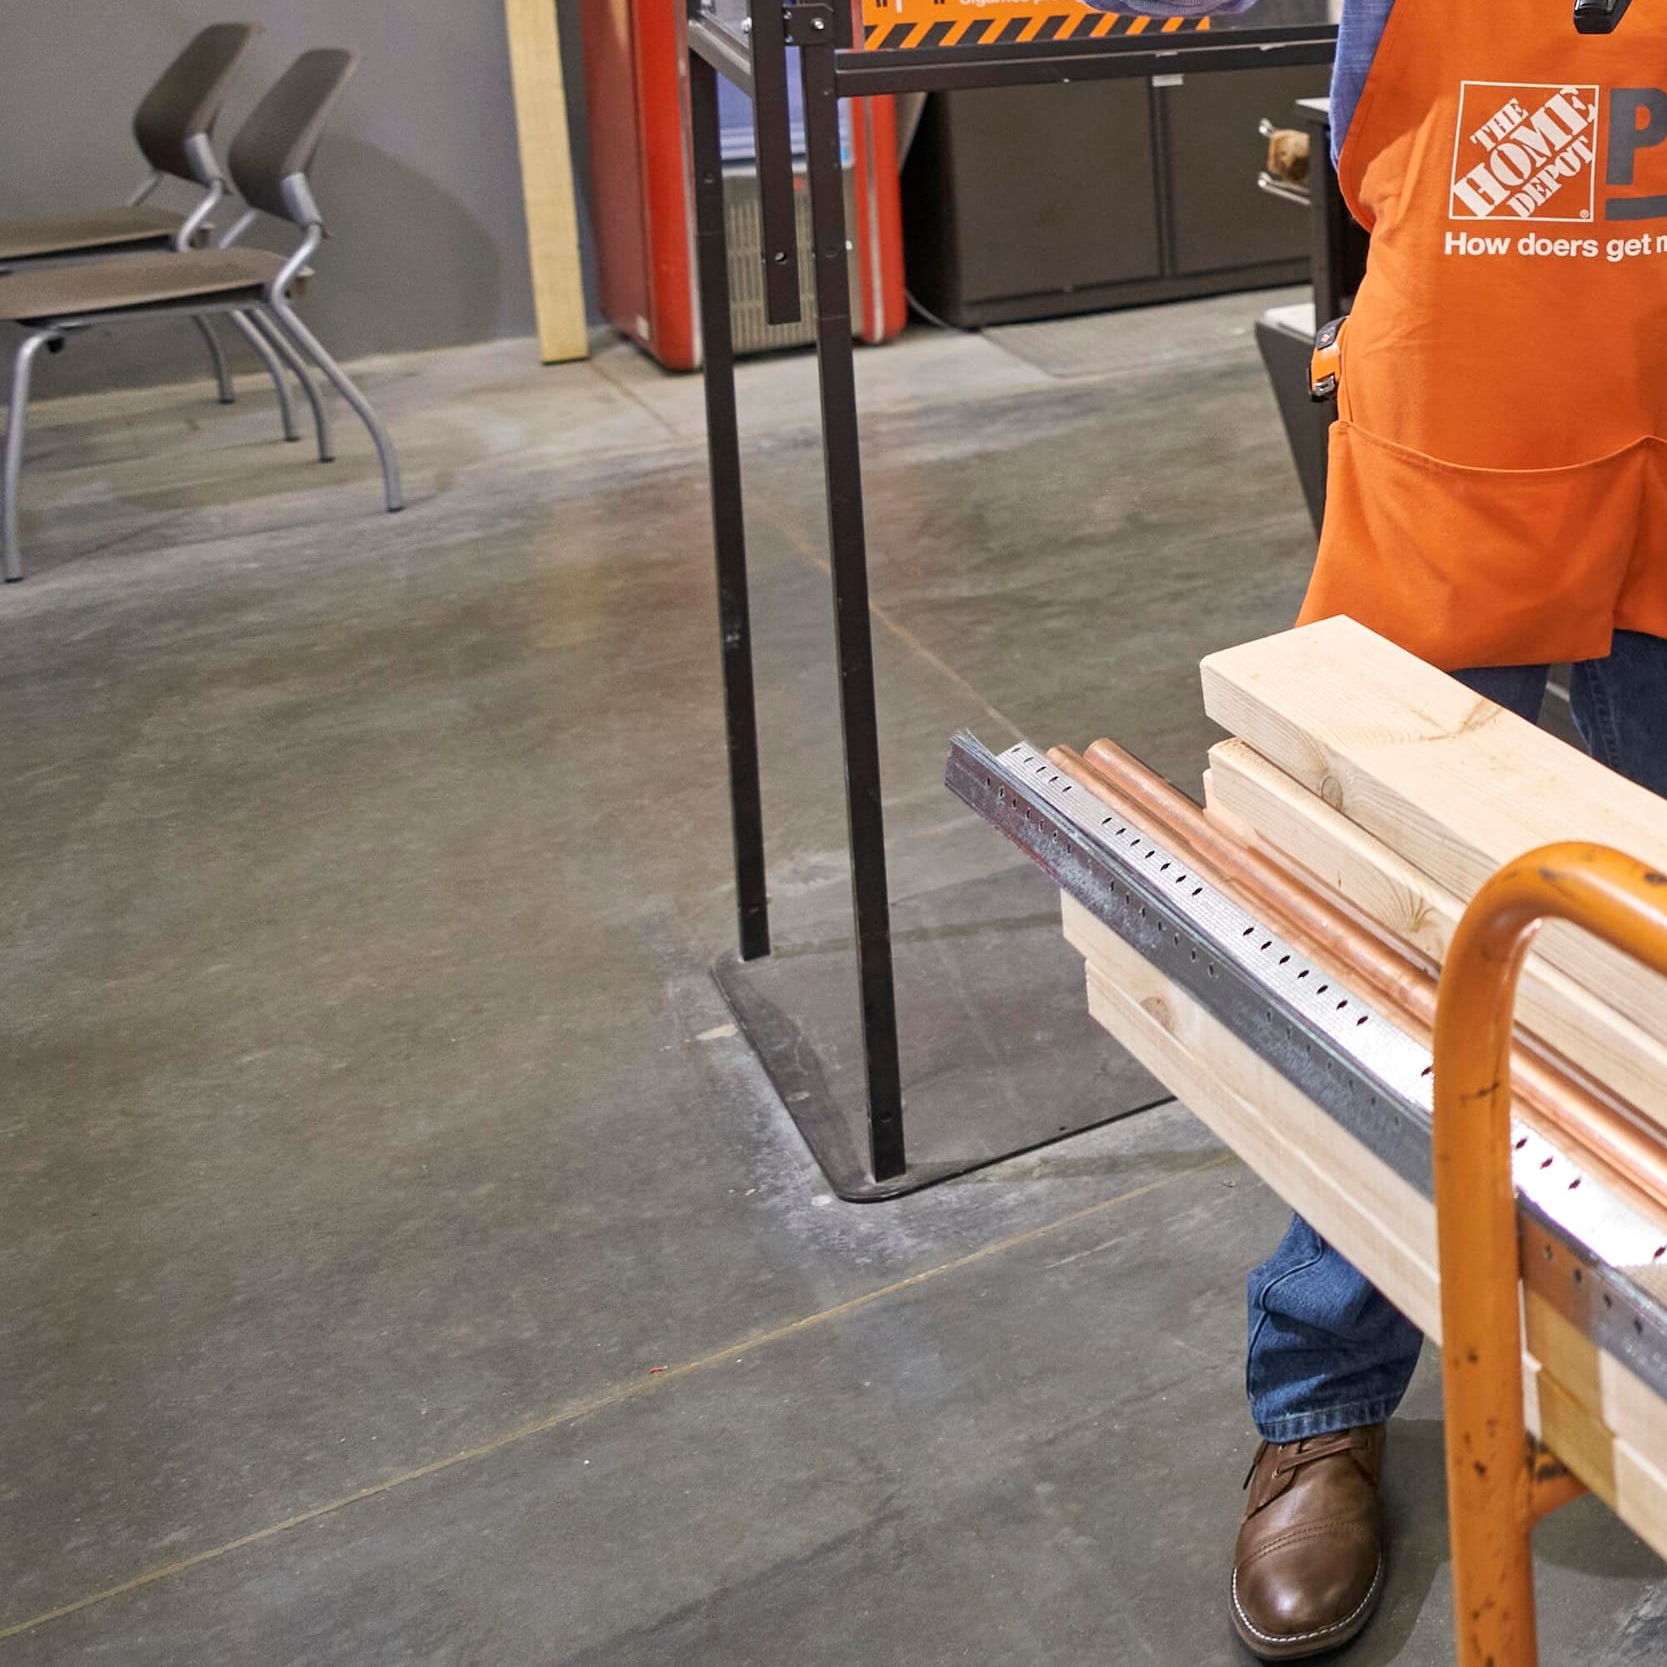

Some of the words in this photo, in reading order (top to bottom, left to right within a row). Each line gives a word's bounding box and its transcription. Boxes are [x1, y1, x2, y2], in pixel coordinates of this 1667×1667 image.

[1452, 86, 1597, 218] HOME
[1470, 97, 1530, 154] THE
[1505, 135, 1594, 219] DEPOT
[1444, 231, 1510, 256] How
[1517, 233, 1599, 258] doers
[1606, 235, 1653, 263] get
